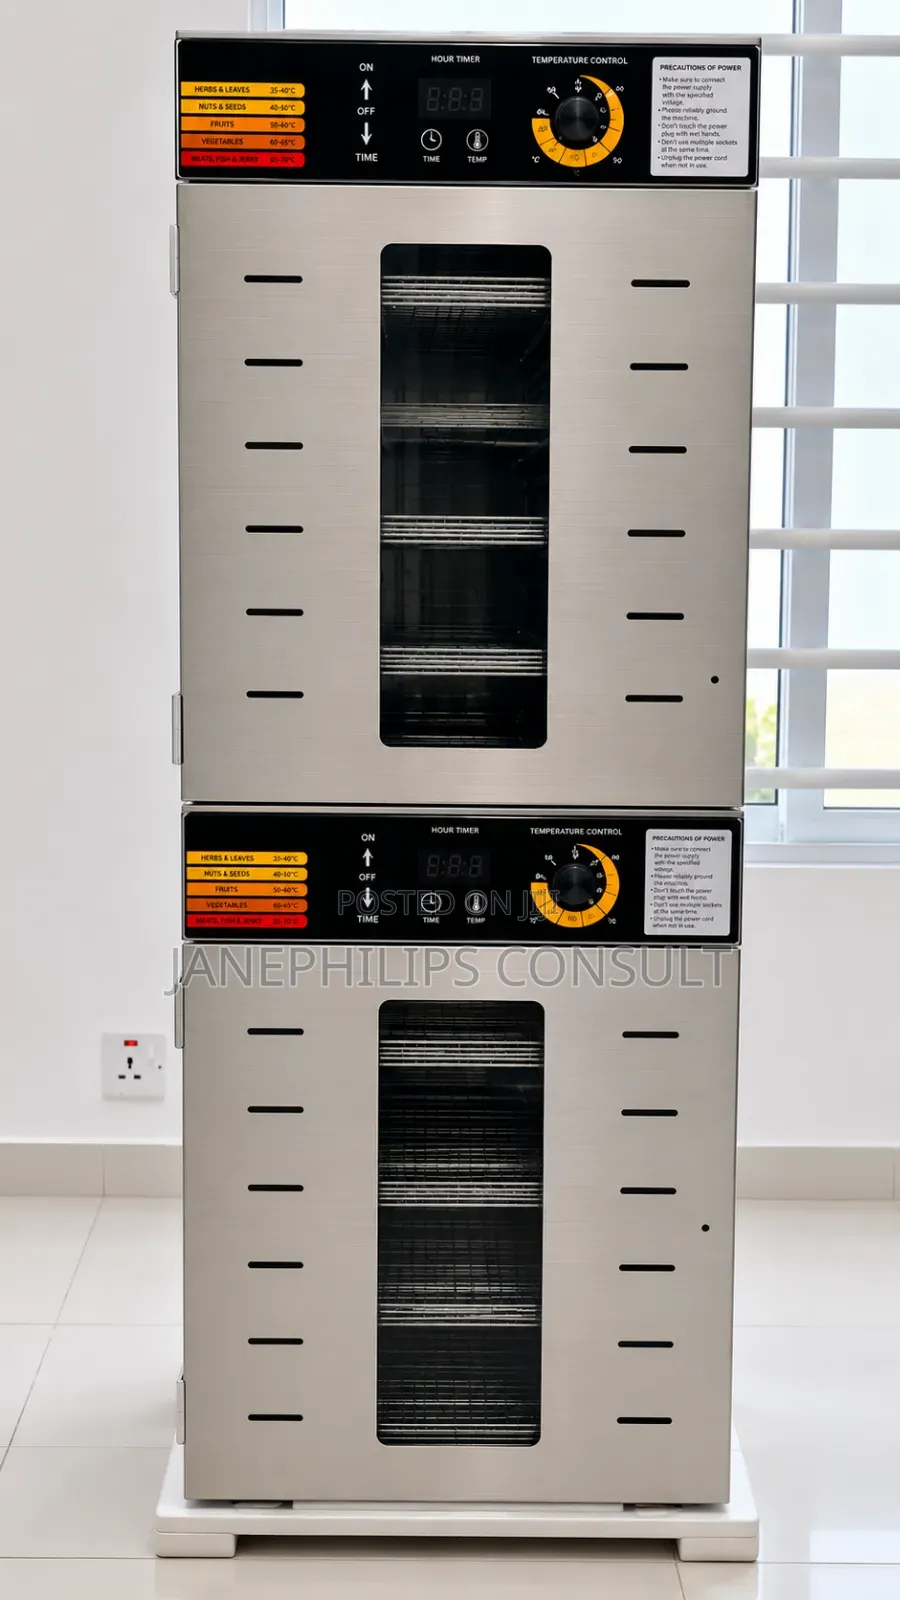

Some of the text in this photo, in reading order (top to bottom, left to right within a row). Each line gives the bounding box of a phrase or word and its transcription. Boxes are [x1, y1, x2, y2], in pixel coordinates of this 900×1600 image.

[431, 55, 480, 63] HOUR TIMER
[532, 56, 628, 65] TEMPERATURE CONTROL
[359, 62, 374, 72] ON
[357, 107, 375, 116] OFF
[355, 153, 378, 162] TIME
[423, 155, 440, 163] TIME
[530, 827, 623, 836] TEMPERATURE CONTROL
[361, 833, 375, 842] ON
[359, 873, 376, 881] OFF
[357, 915, 379, 924] TIME
